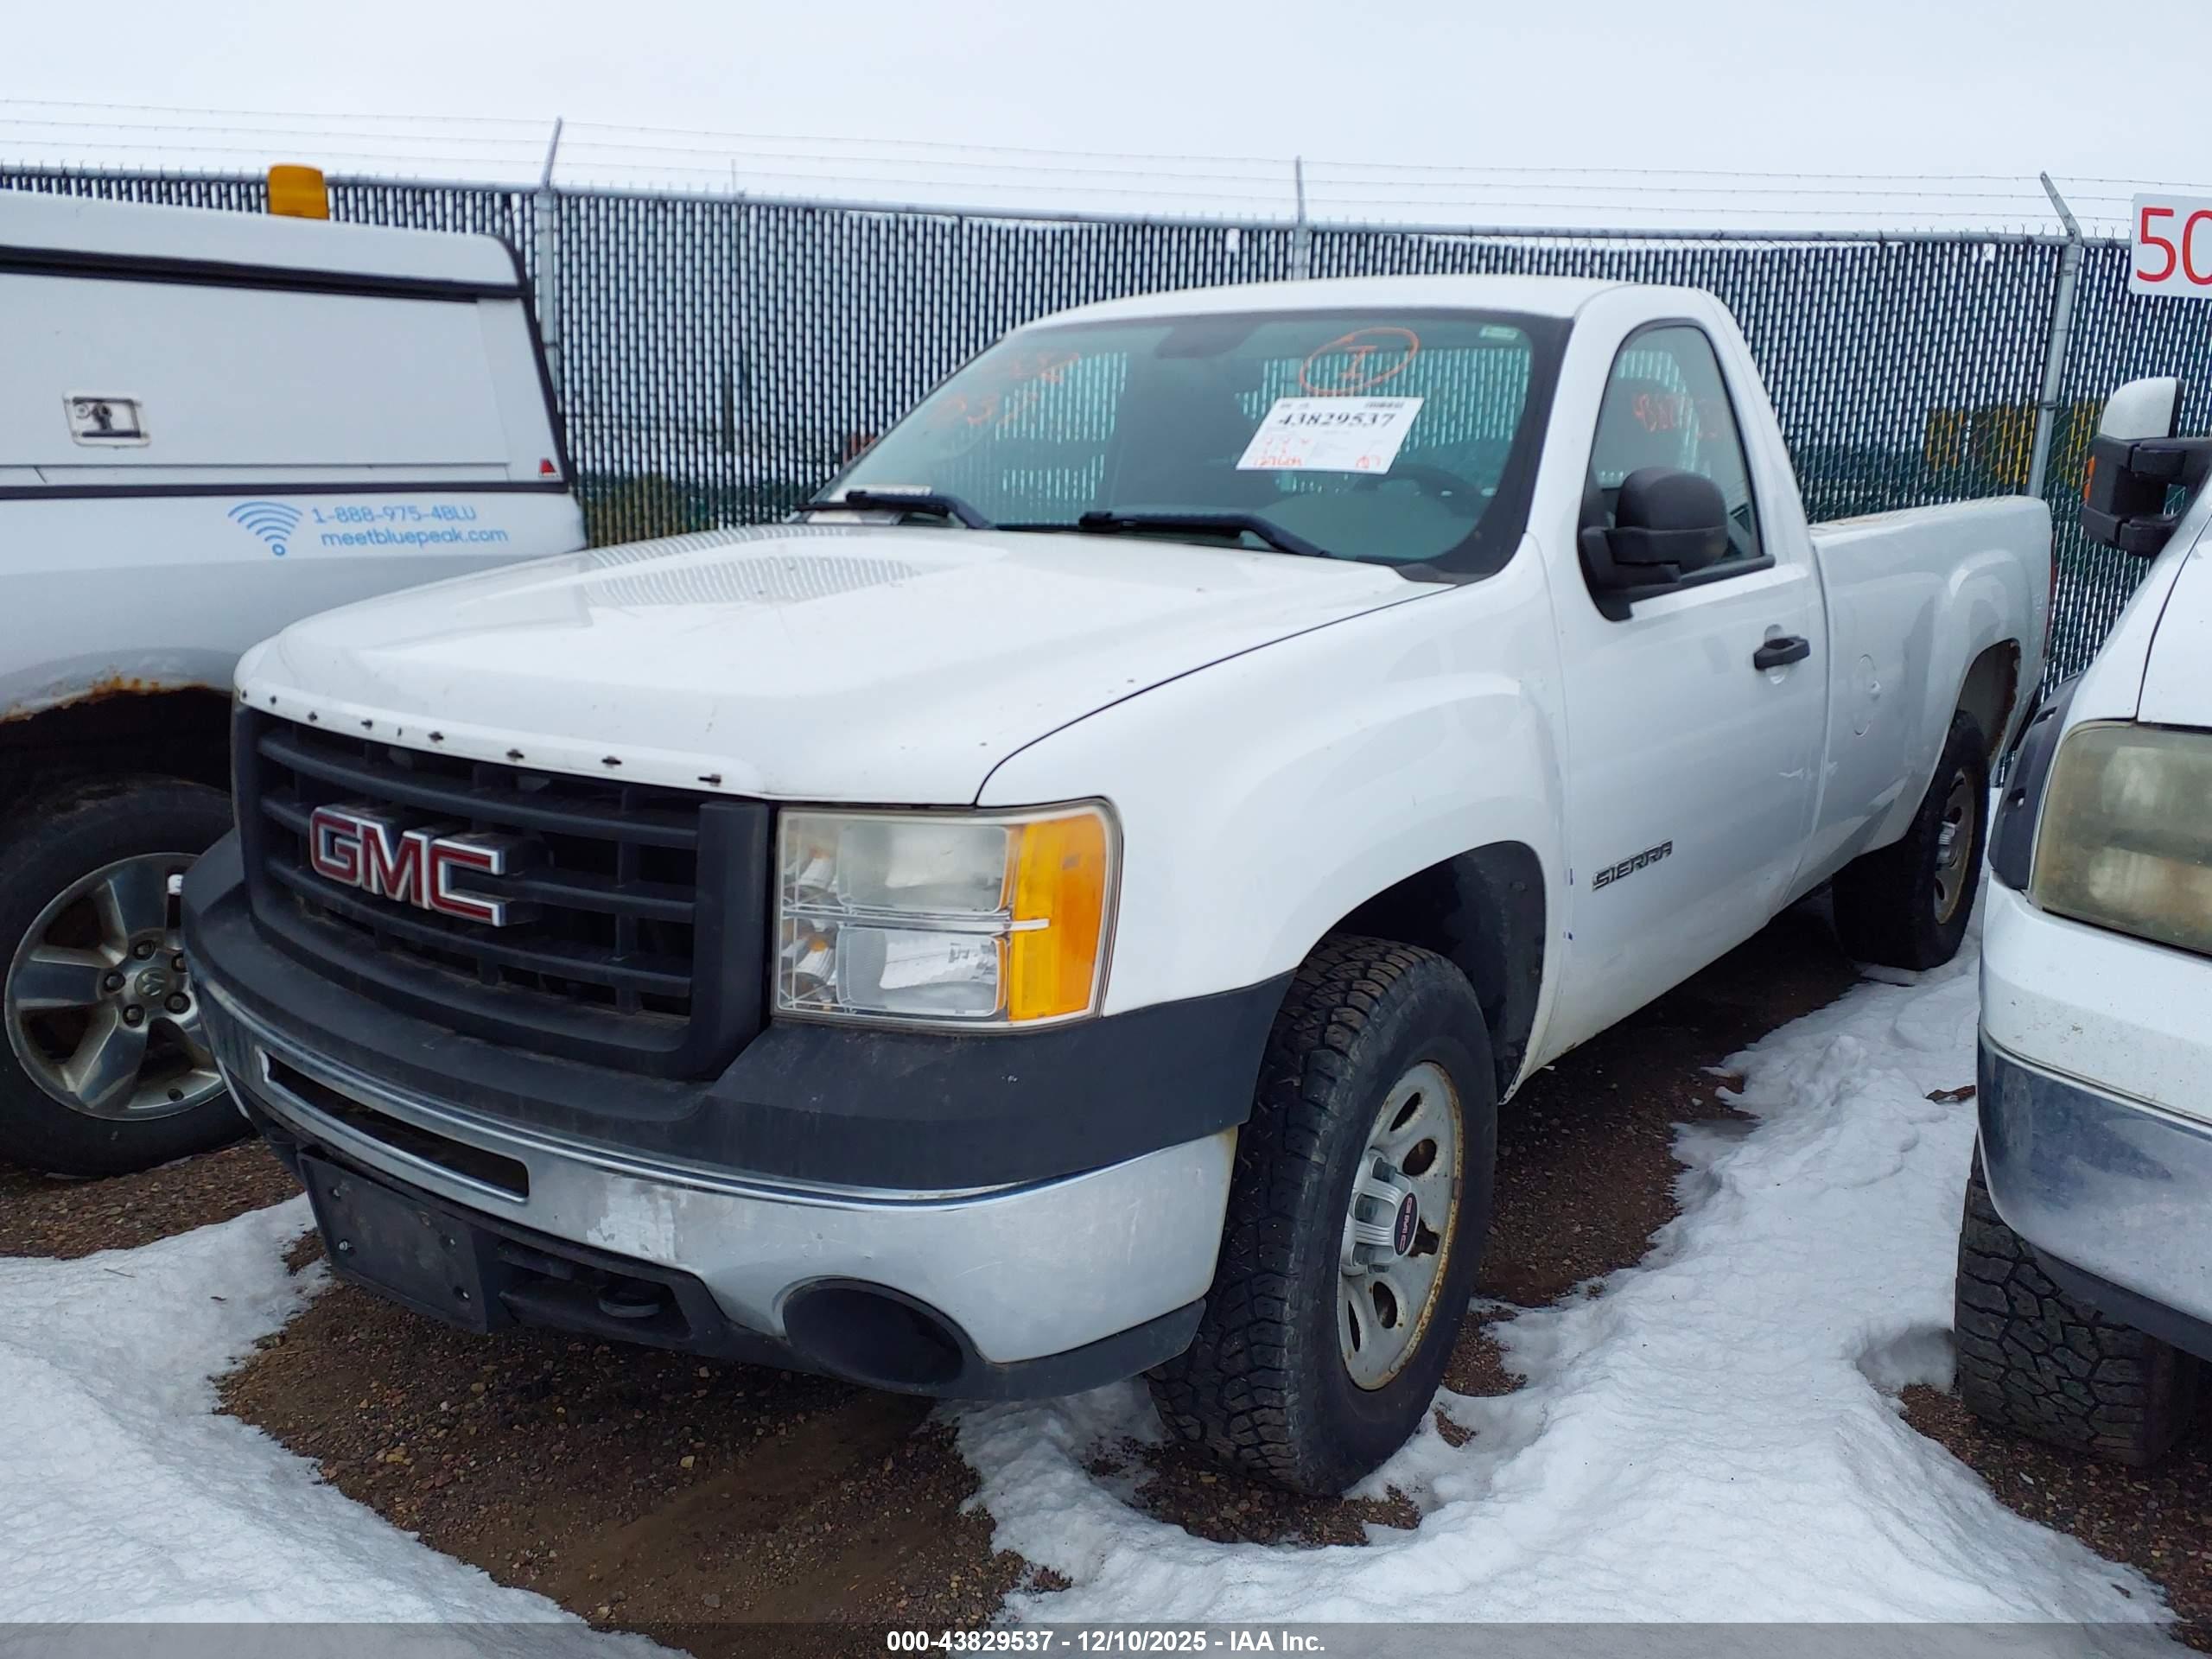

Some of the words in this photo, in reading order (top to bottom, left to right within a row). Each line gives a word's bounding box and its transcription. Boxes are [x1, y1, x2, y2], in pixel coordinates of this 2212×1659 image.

[2136, 207, 2212, 286] 50
[1278, 411, 1396, 427] 43829537
[311, 505, 478, 524] 1-888-975-4BLU
[321, 528, 509, 548] meetbluepeak.com
[309, 805, 506, 928] GMC
[1592, 837, 1674, 892] SIERRA
